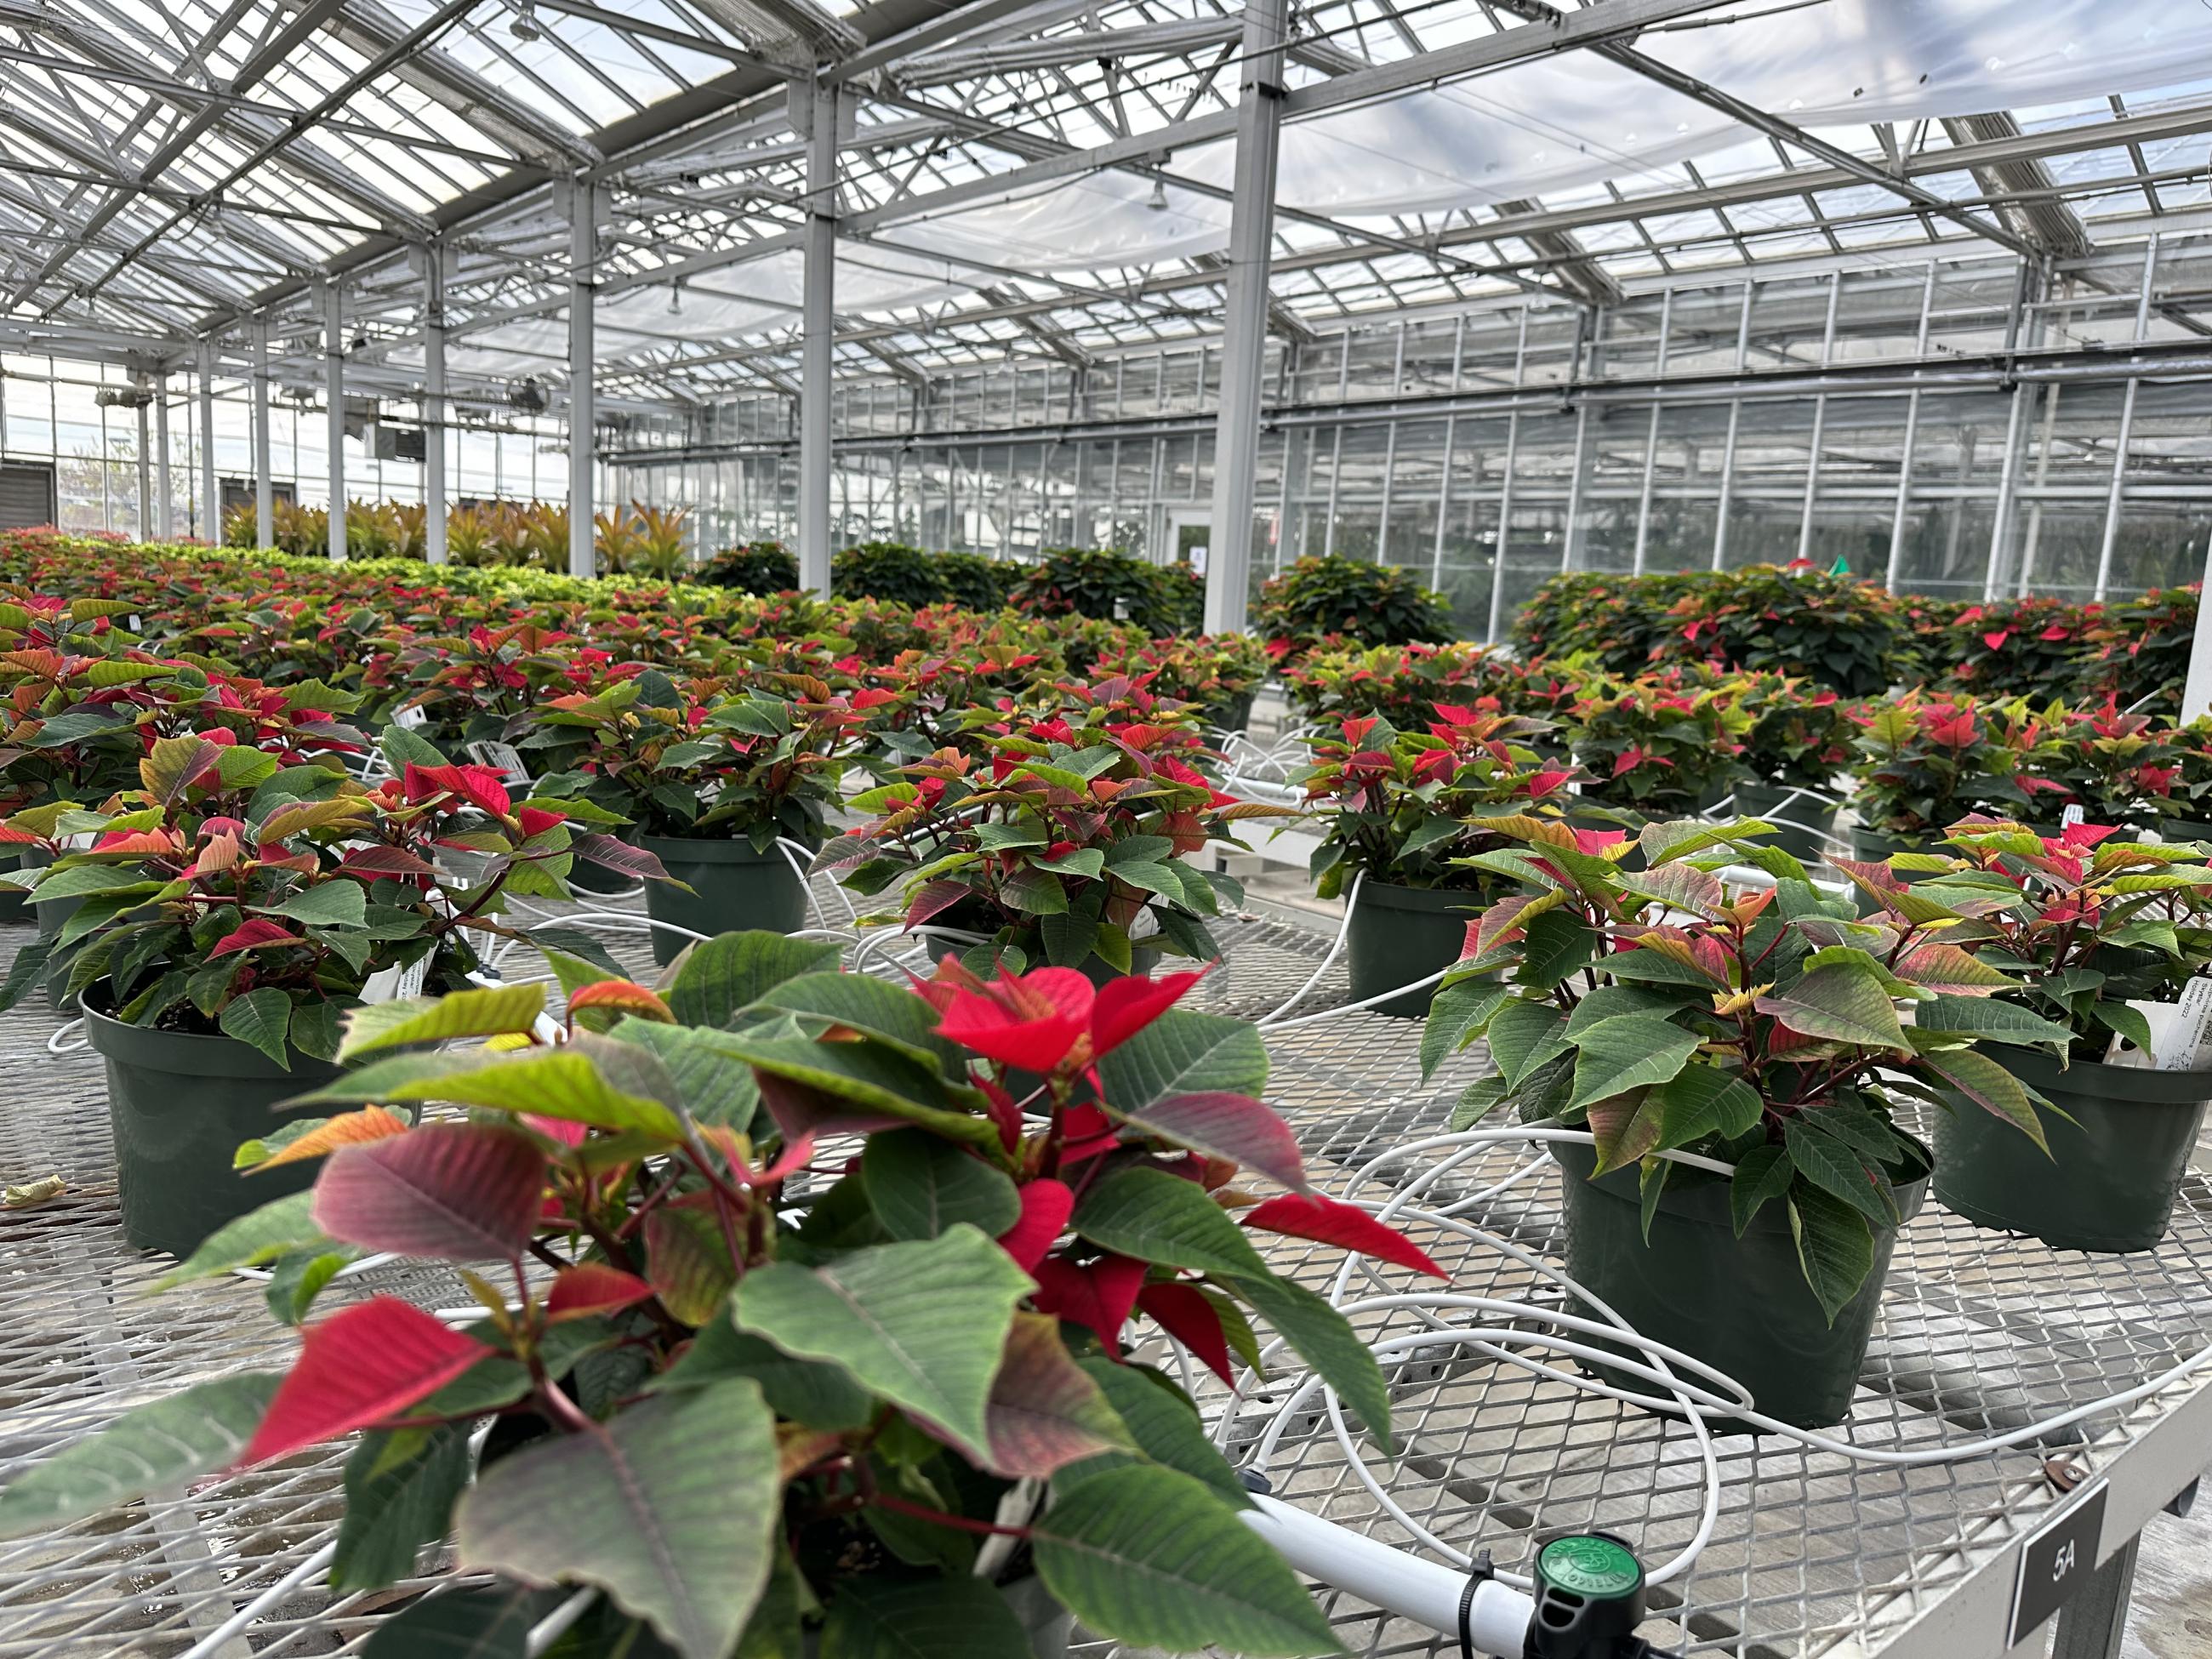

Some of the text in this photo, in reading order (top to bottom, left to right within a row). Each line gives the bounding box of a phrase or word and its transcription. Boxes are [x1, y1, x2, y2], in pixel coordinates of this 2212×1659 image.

[2181, 979, 2199, 1018] Holiday 2022
[2053, 1538, 2074, 1582] 5A
